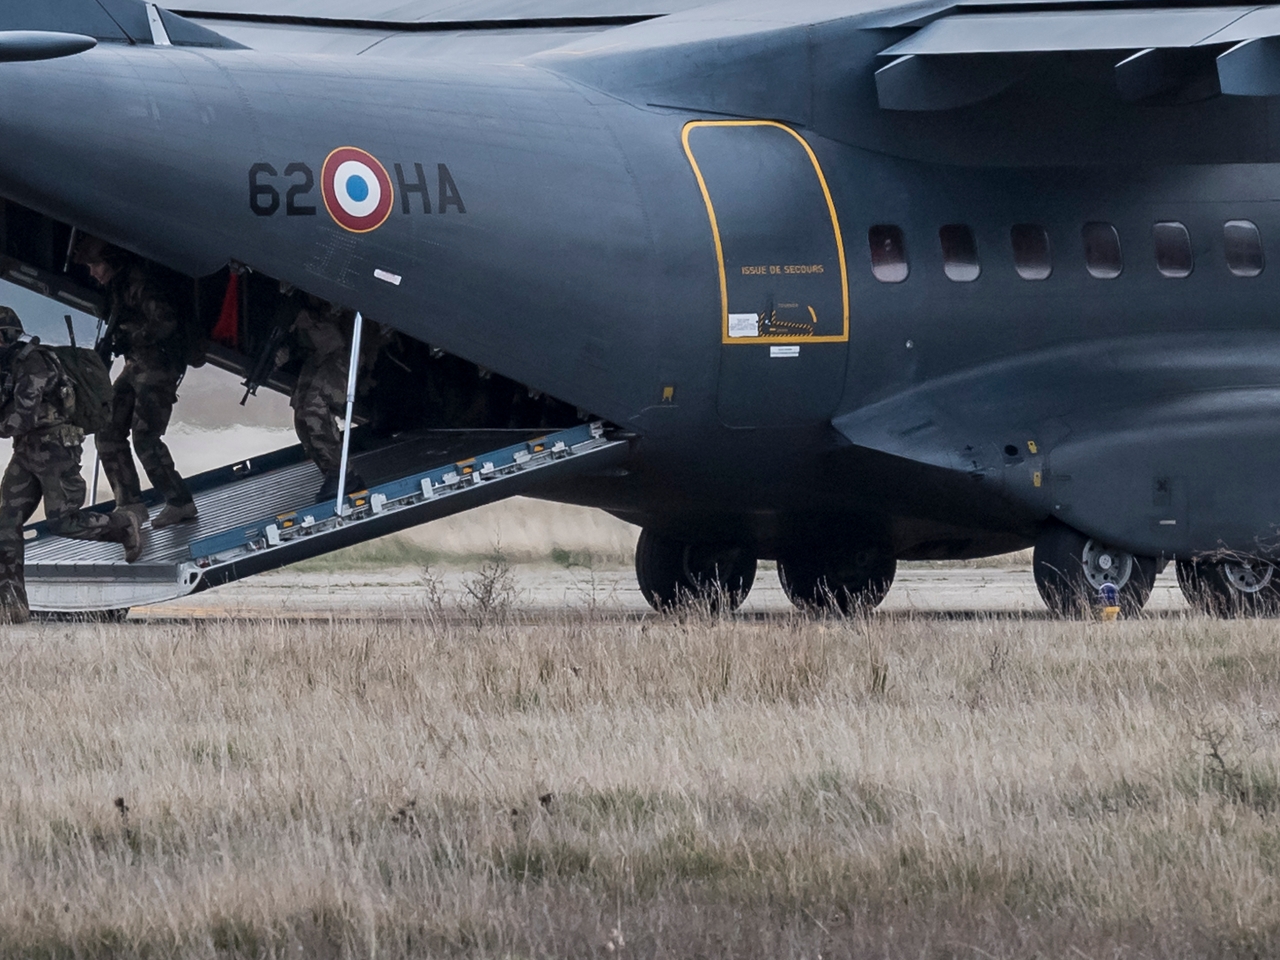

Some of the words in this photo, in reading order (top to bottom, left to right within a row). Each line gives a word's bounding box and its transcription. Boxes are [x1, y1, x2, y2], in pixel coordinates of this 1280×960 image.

[248, 162, 317, 216] 62
[393, 162, 467, 215] HA
[741, 266, 766, 275] ISSUE
[769, 266, 781, 275] DE
[784, 265, 824, 275] SECOURS
